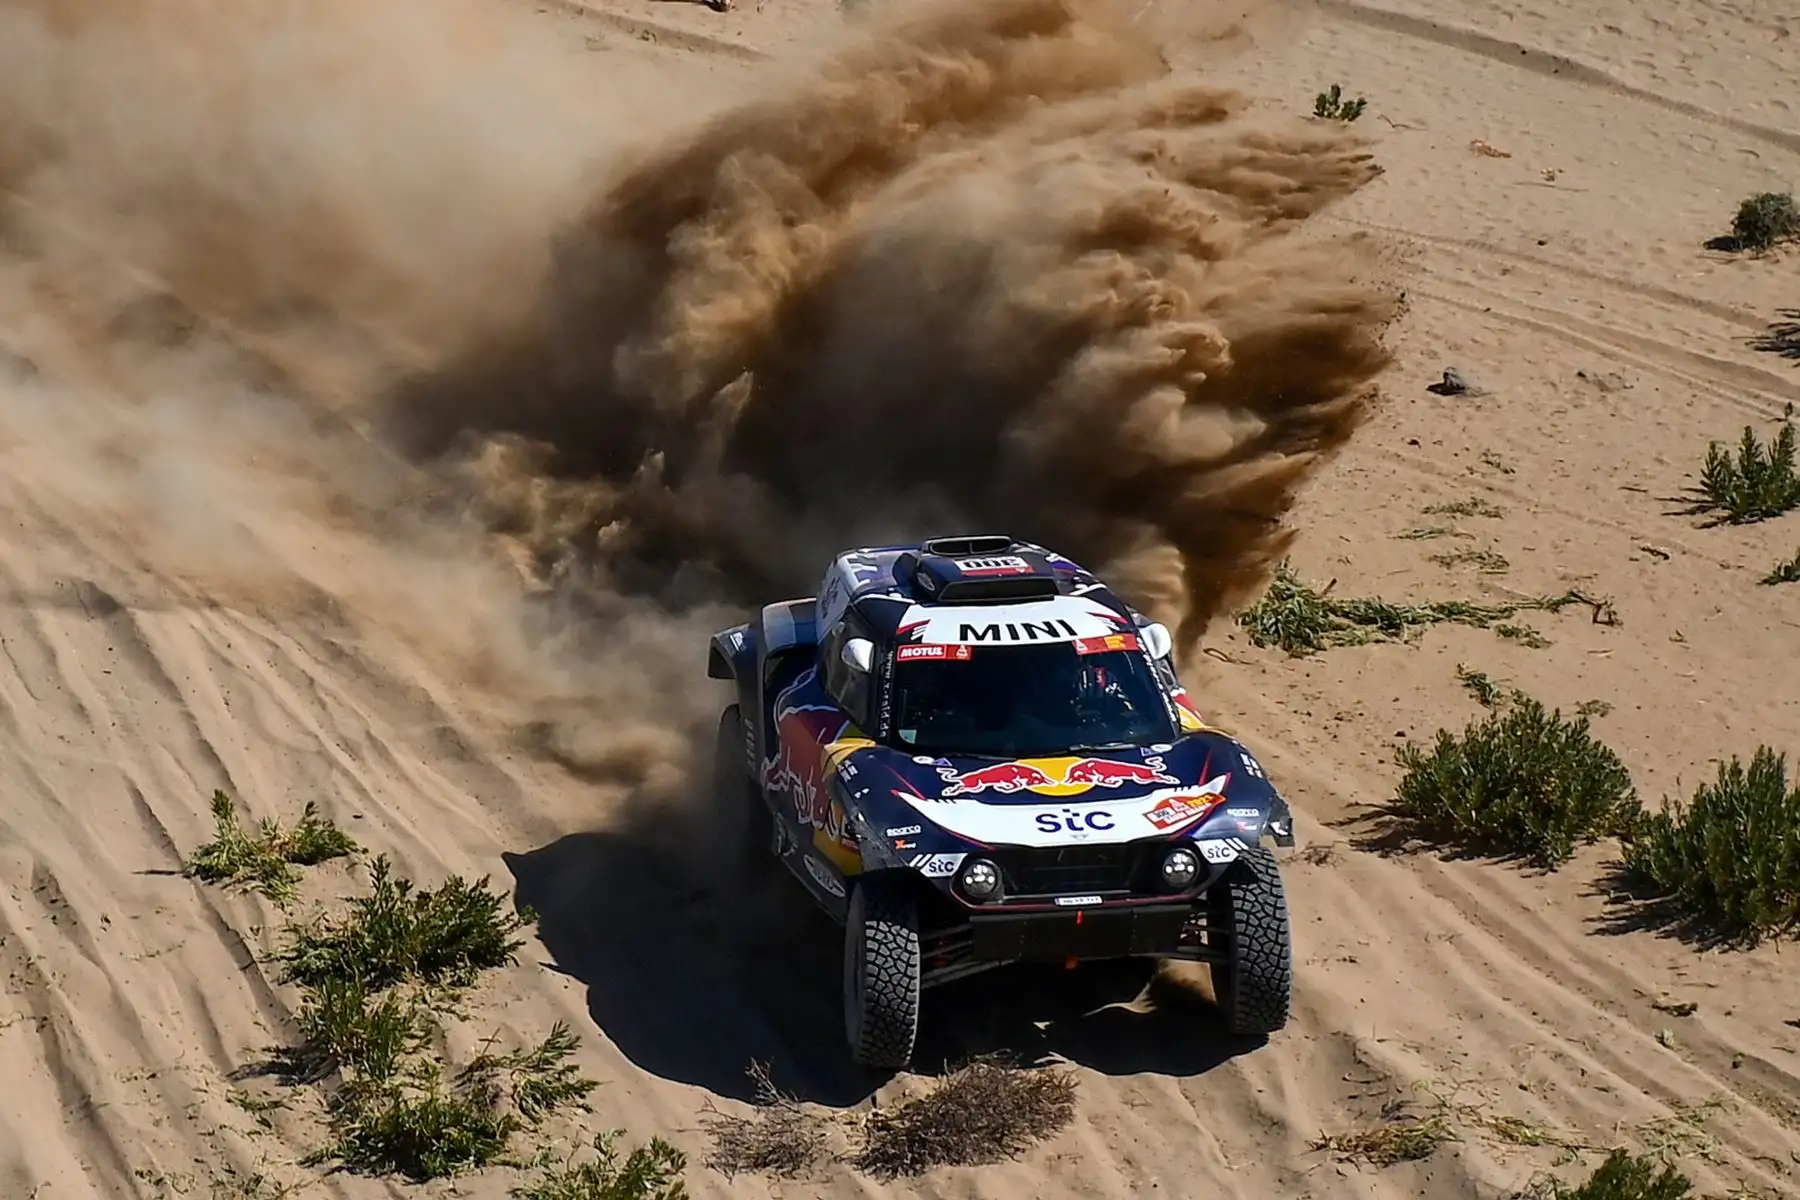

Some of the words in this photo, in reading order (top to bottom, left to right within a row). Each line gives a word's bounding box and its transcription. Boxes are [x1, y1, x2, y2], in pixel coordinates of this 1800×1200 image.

[959, 618, 1078, 641] MINI
[901, 646, 943, 657] MOTUL
[886, 825, 922, 837] sparco
